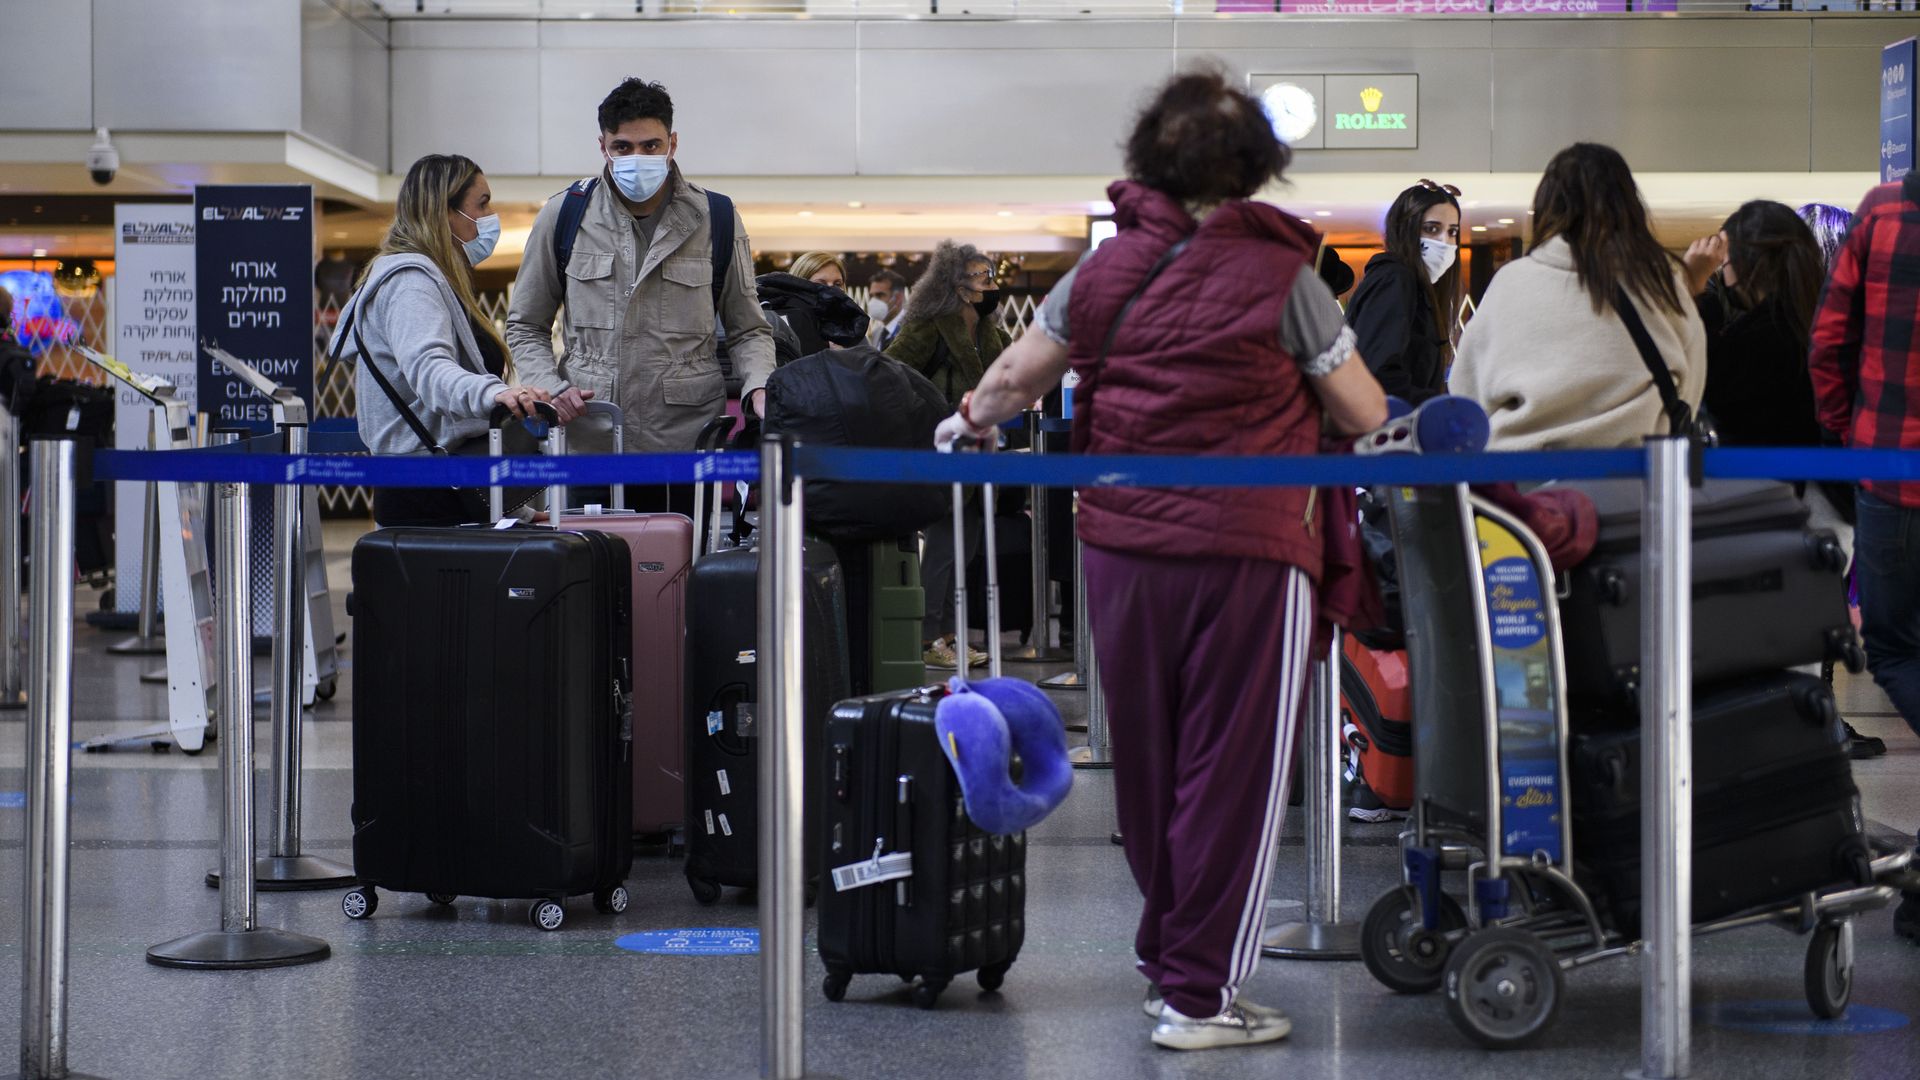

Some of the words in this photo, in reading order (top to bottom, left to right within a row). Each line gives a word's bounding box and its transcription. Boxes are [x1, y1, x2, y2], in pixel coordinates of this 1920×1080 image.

[1335, 113, 1407, 129] ROLEX
[150, 271, 186, 284] אורחי
[231, 261, 277, 278] אורחי
[143, 286, 193, 305] מחלקת
[221, 282, 286, 308] מחלקת
[144, 307, 188, 324] עסקים
[228, 311, 280, 328] תיירים
[123, 325, 158, 341] יוקרה
[211, 359, 299, 375] ECNOMY
[1495, 615, 1526, 625] WORLD
[1495, 625, 1539, 636] AIRPORTS
[1508, 775, 1553, 787] EVERYONE
